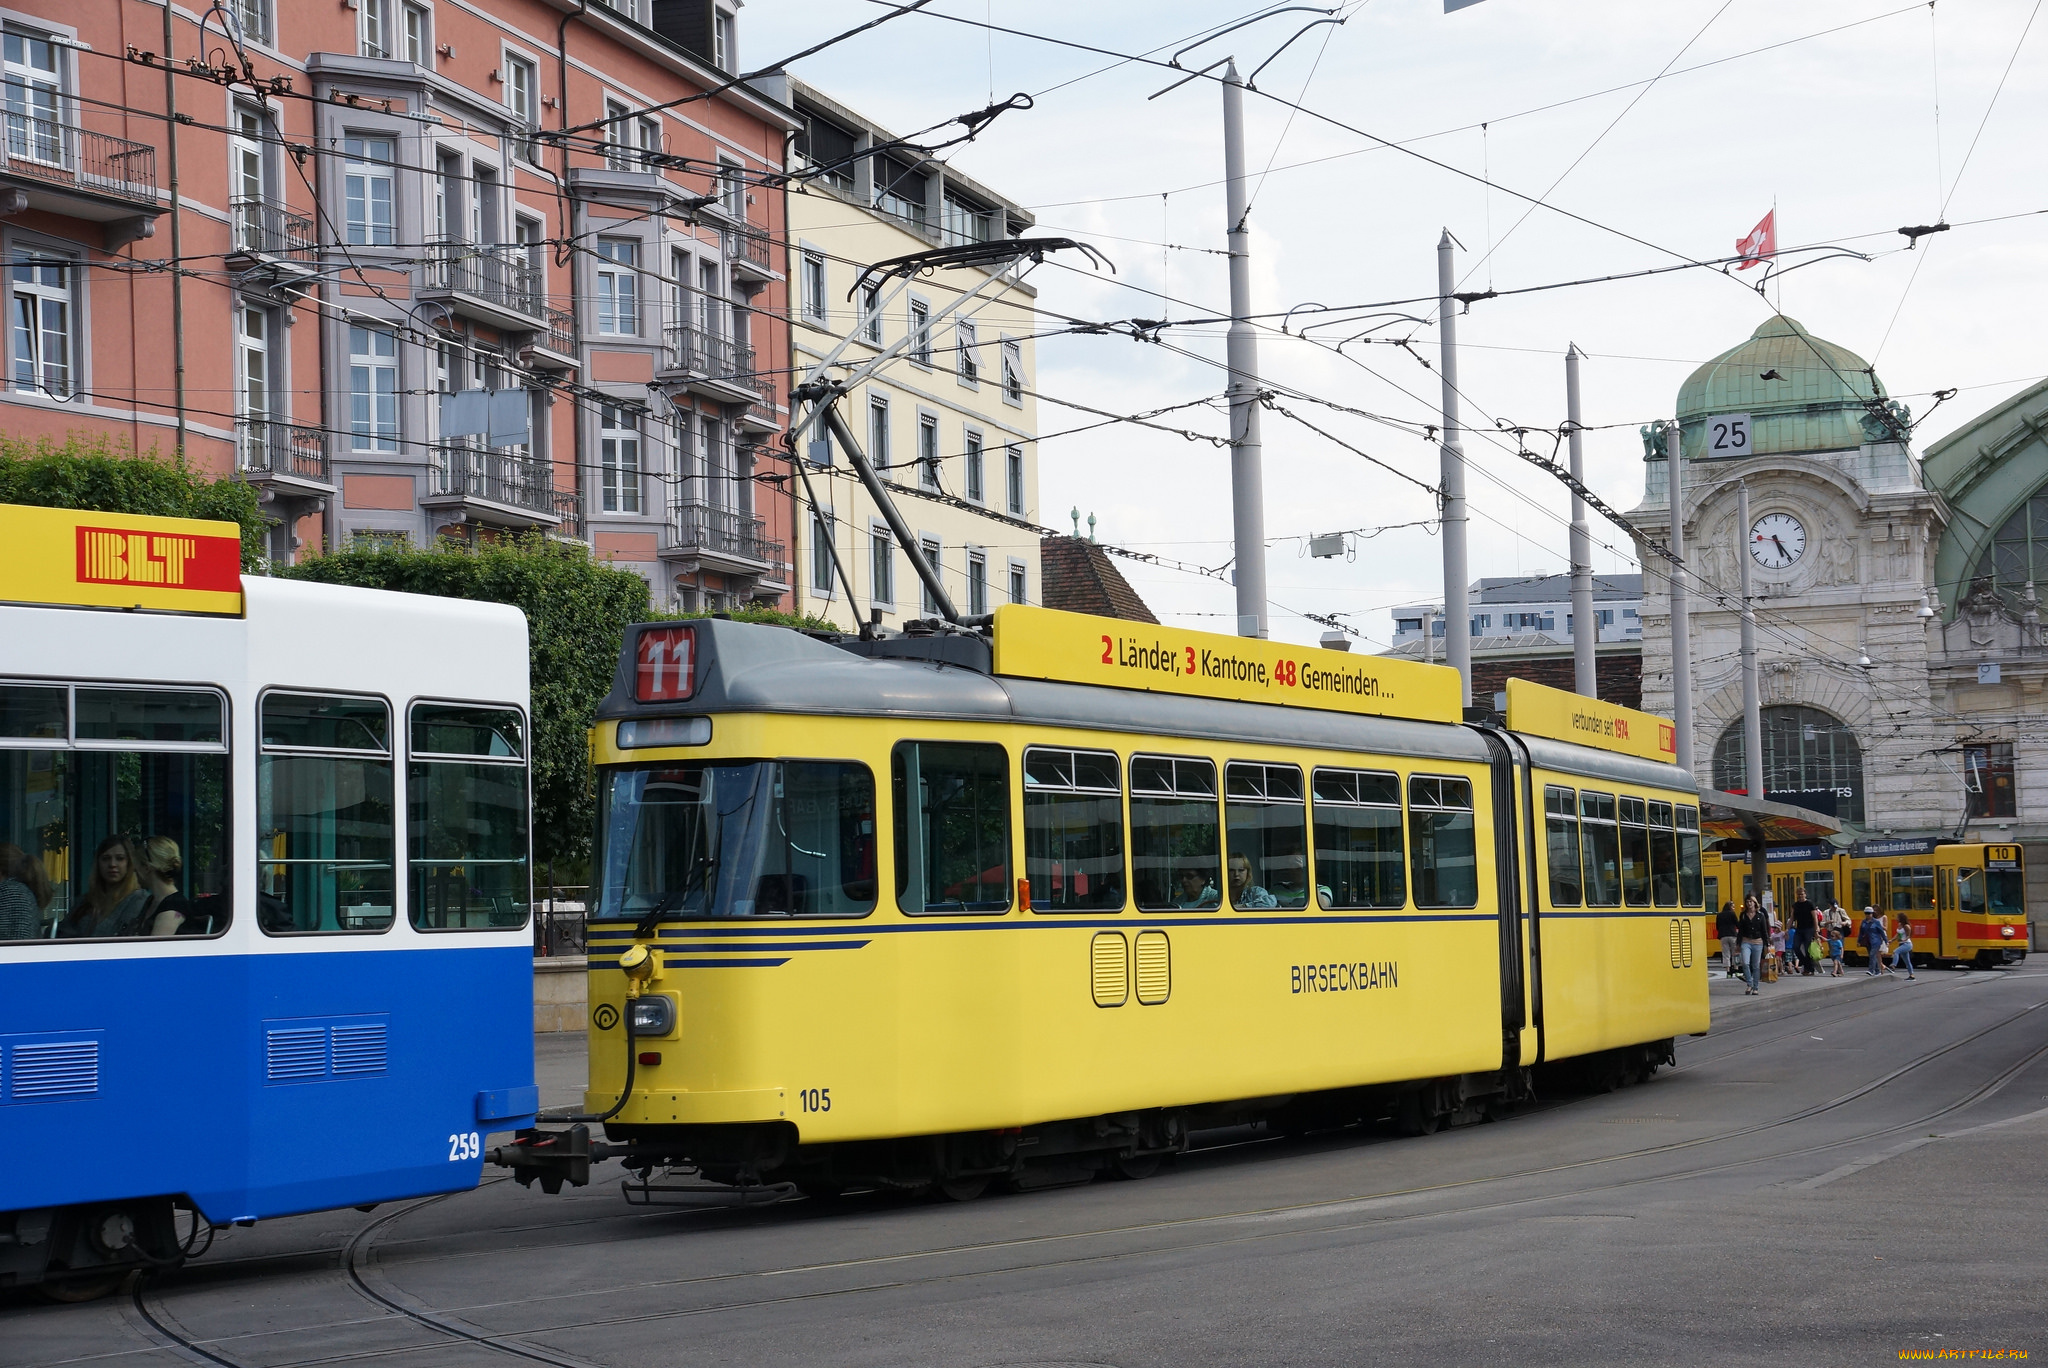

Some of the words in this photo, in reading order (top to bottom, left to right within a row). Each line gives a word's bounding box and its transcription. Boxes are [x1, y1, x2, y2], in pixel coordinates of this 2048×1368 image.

[1713, 421, 1746, 449] 25
[85, 531, 196, 585] BLT
[647, 639, 690, 693] 11
[1101, 635, 1113, 665] 2
[1119, 637, 1180, 677] Länder,
[1185, 646, 1196, 675] 3
[1201, 649, 1270, 687] Kantone,
[1274, 659, 1297, 687] 48
[1571, 708, 1602, 734] verbunden
[1604, 715, 1614, 738] seit
[1995, 847, 2009, 860] 10
[1291, 961, 1398, 994] BIRSECKBAHN
[800, 1088, 831, 1112] 105
[449, 1132, 480, 1161] 259
